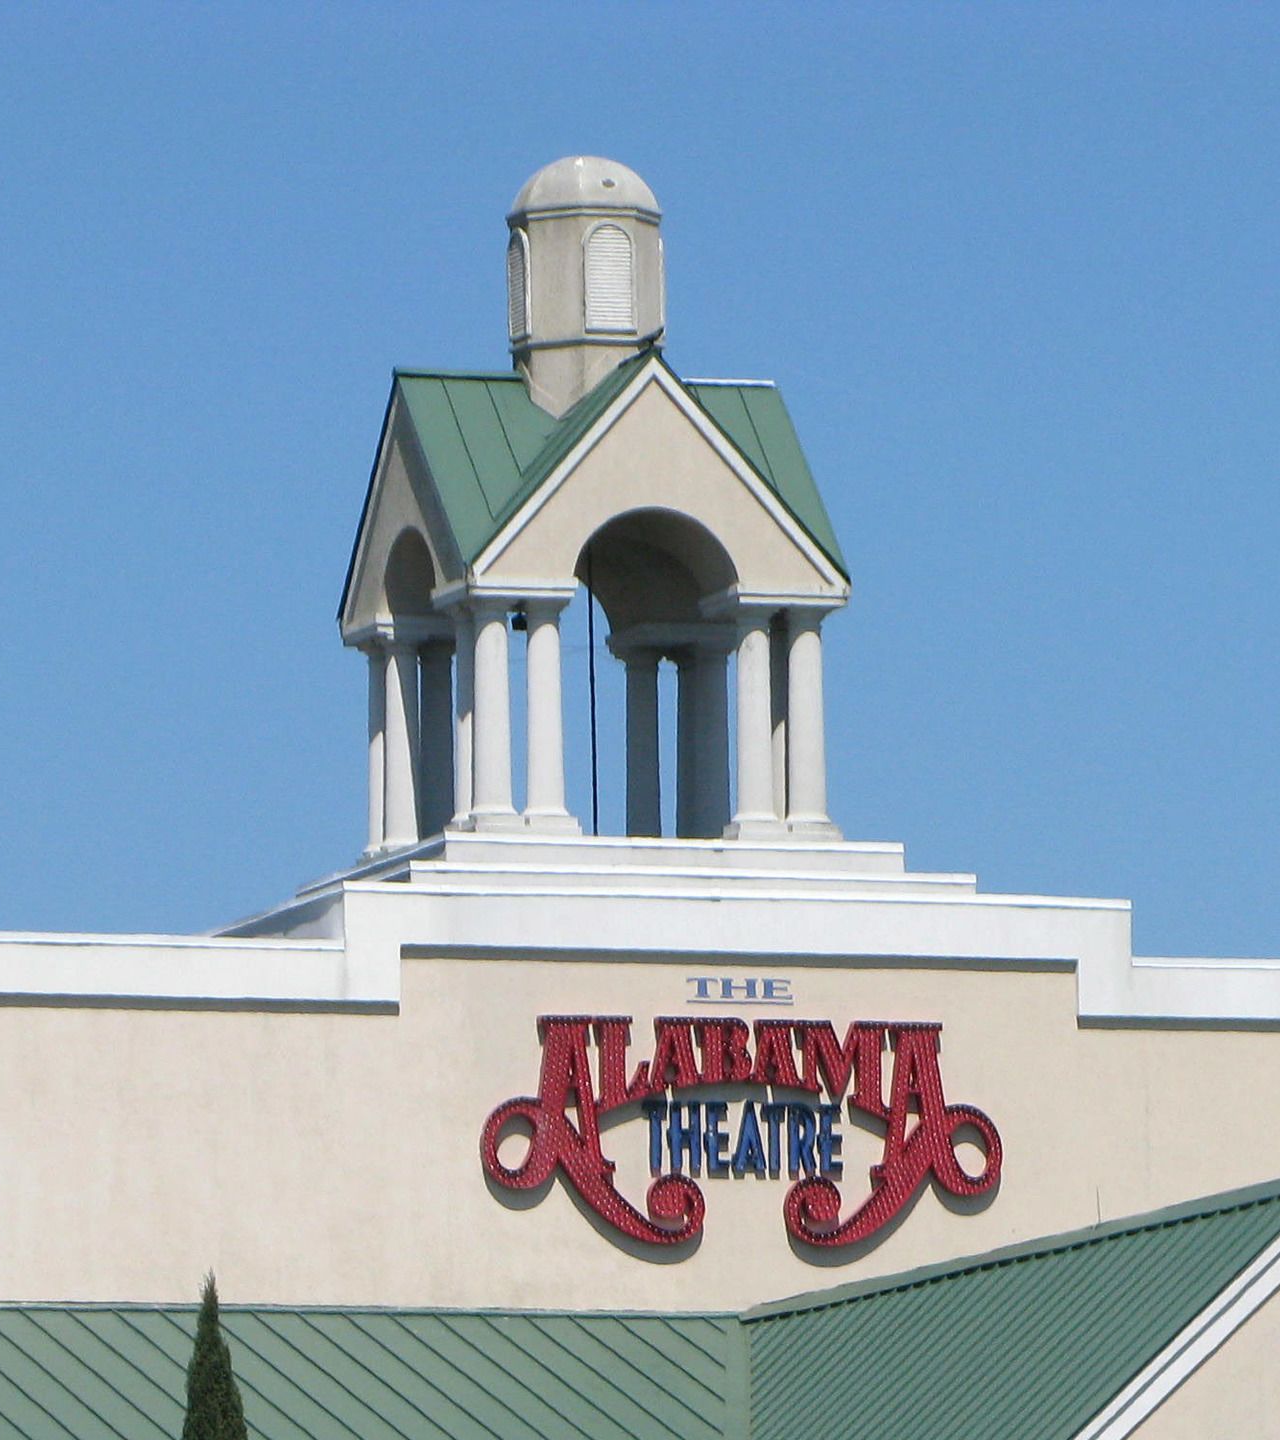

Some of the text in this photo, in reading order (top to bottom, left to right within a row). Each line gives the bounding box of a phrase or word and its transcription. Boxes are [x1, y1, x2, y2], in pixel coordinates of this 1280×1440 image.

[686, 977, 793, 1001] THE
[481, 1015, 1003, 1248] ALABAMA
[641, 1099, 843, 1178] THEATRE
